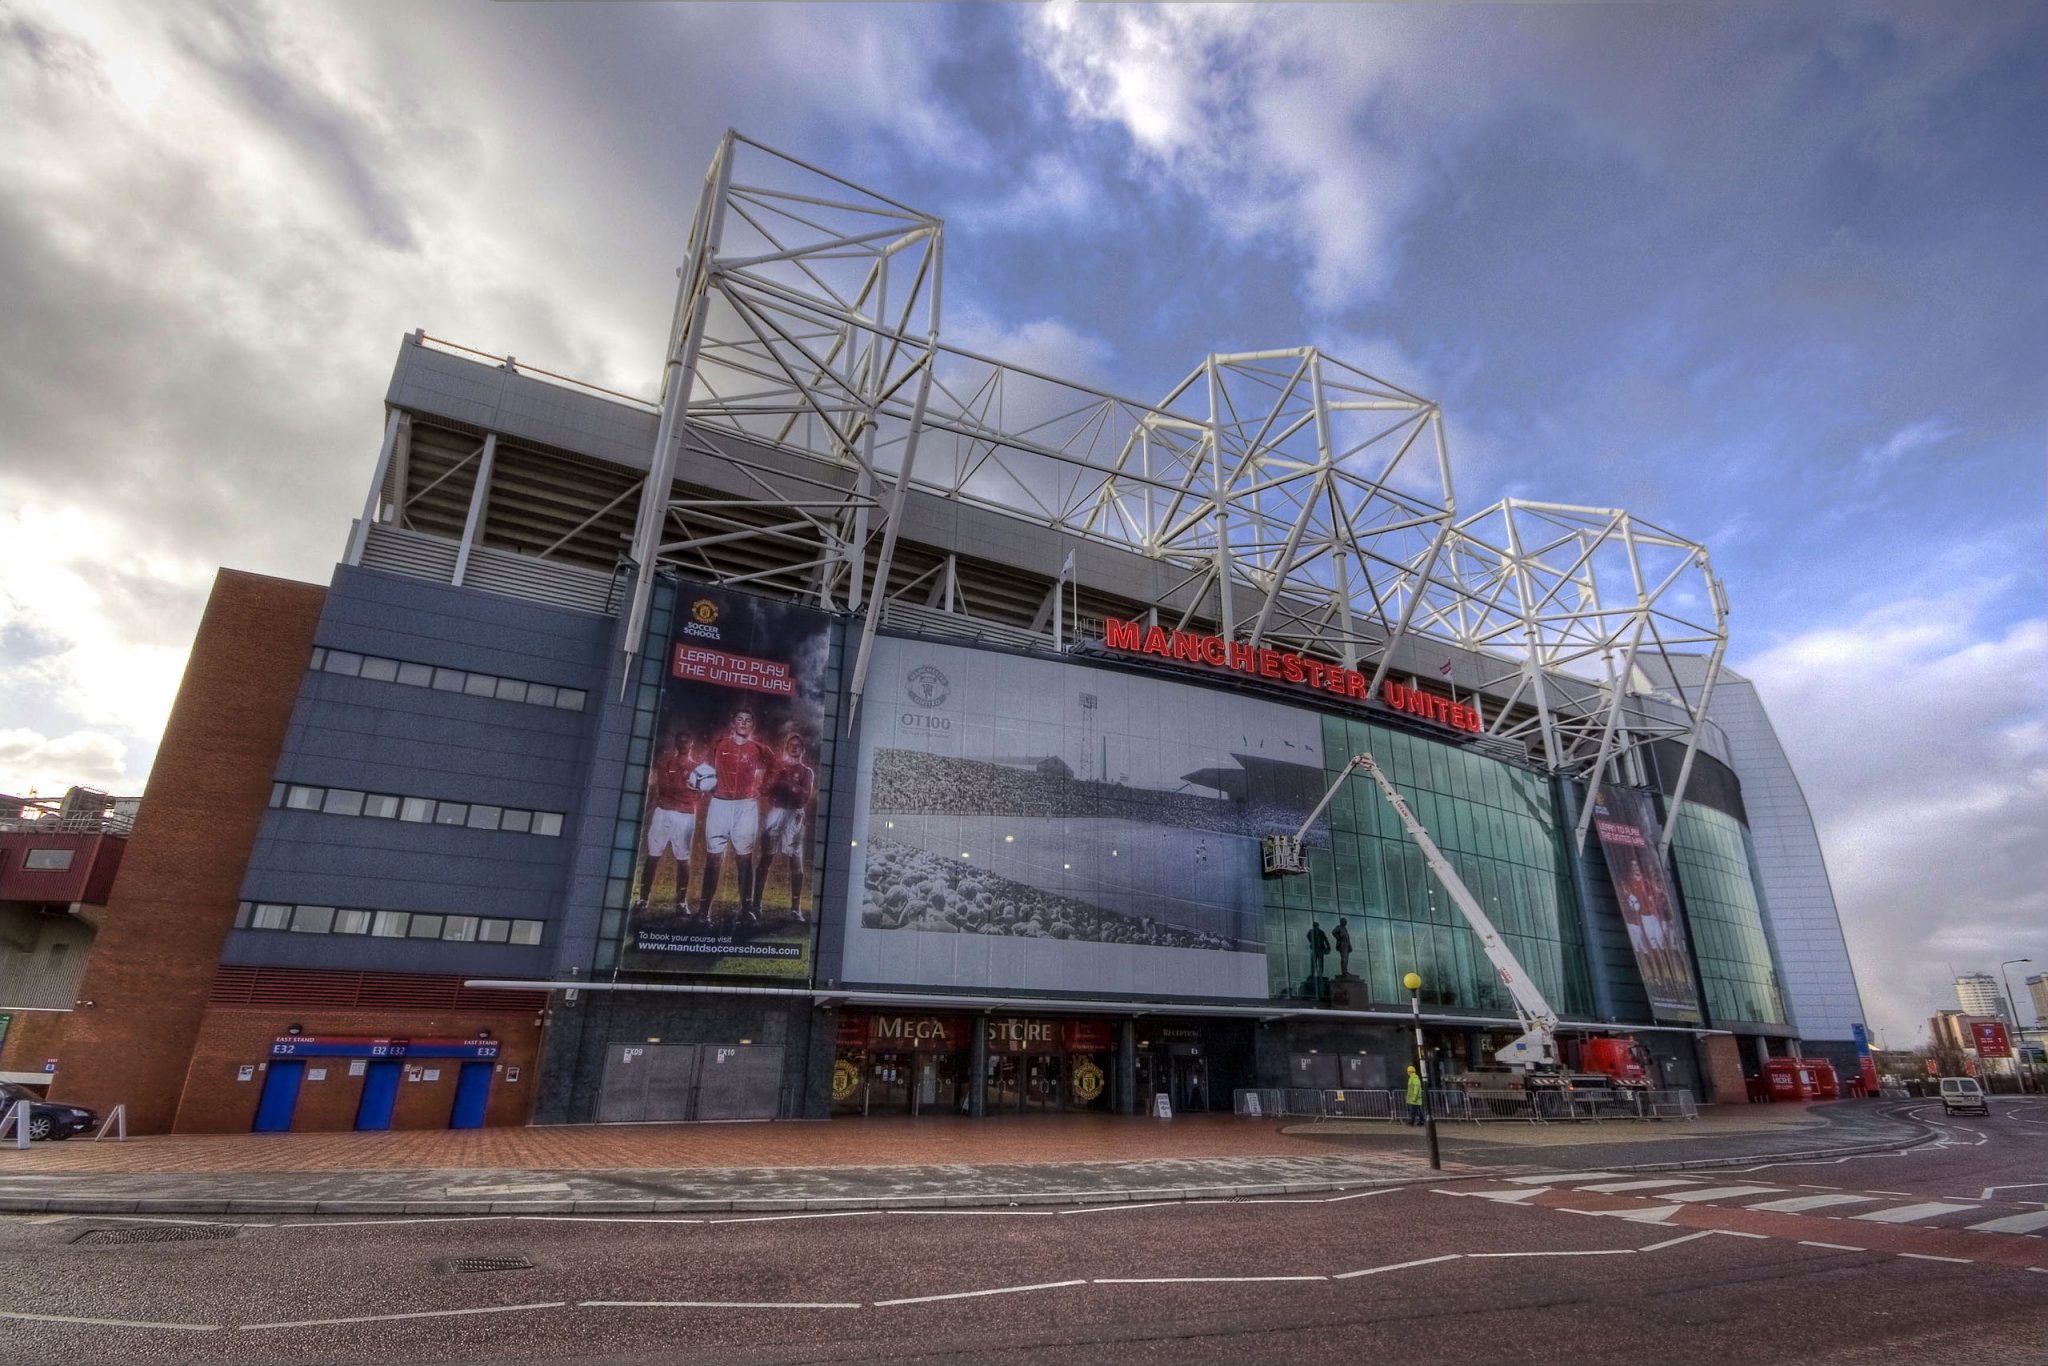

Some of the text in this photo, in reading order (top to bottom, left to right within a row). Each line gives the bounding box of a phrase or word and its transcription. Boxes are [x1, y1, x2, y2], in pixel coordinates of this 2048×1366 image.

[683, 627, 720, 640] SCHOOLS
[687, 621, 718, 633] SOCCER
[680, 648, 784, 678] LEARN TO PLAY
[678, 662, 792, 692] THE UNITED WAY
[1106, 617, 1481, 733] MANCHESTER UNITED
[901, 713, 951, 730] OT100
[639, 931, 648, 940] To
[650, 932, 669, 941] book
[671, 934, 688, 943] your
[690, 935, 716, 943] course
[638, 941, 799, 956] www.manutdsoccerschools.com
[878, 1017, 946, 1039] MEGA
[273, 1045, 295, 1054] E32
[372, 1046, 387, 1055] E32
[390, 1046, 406, 1055] E32
[477, 1047, 496, 1056] E32
